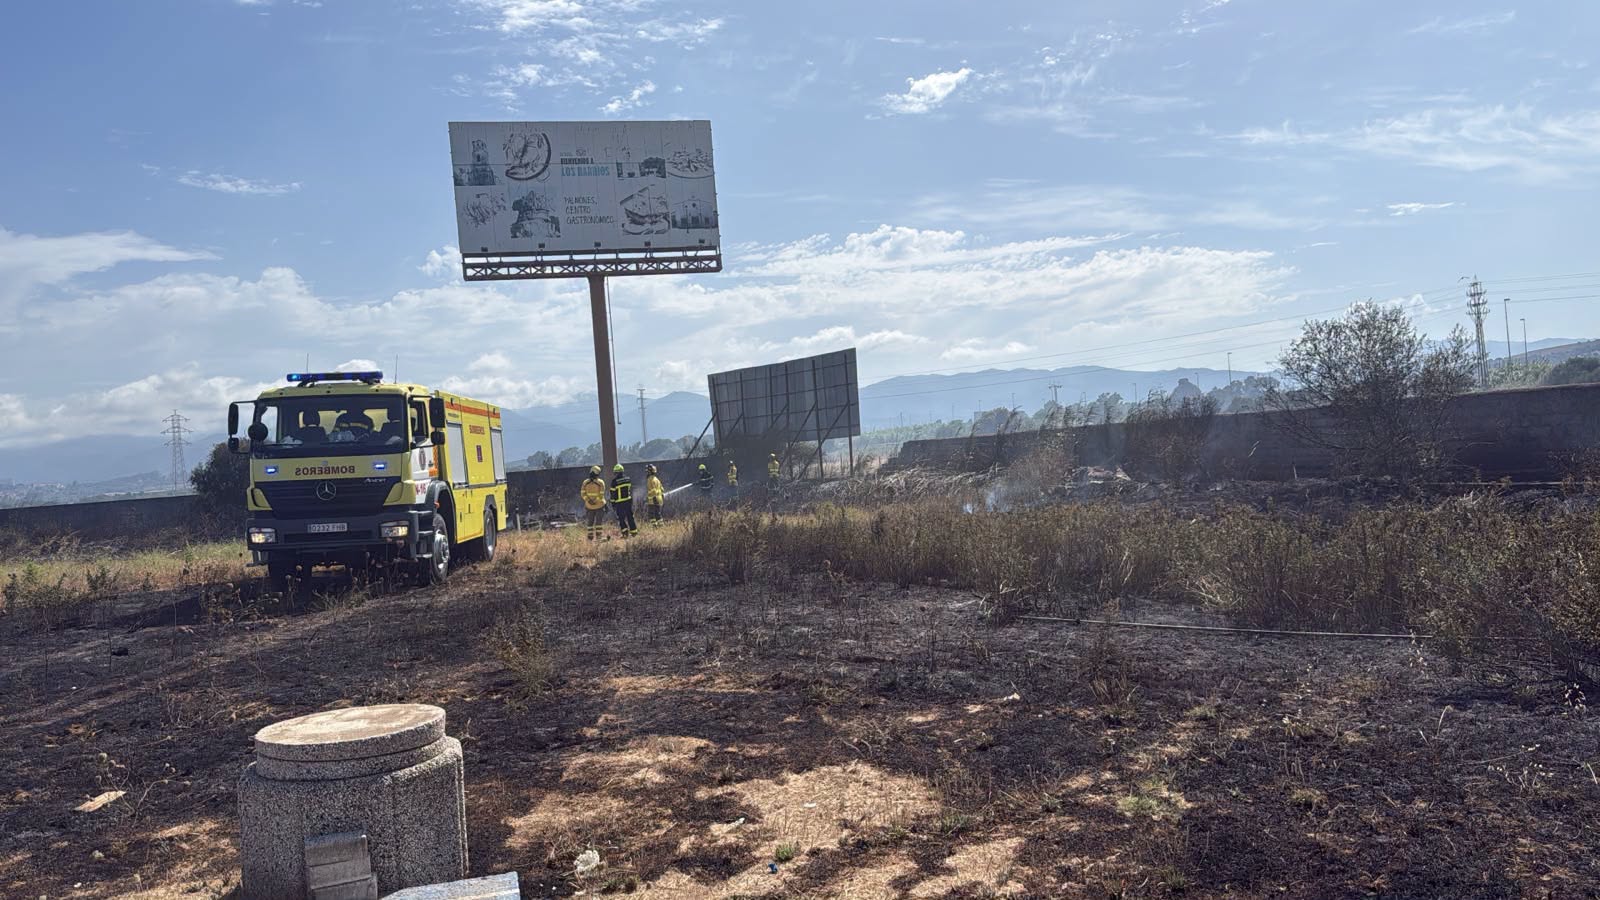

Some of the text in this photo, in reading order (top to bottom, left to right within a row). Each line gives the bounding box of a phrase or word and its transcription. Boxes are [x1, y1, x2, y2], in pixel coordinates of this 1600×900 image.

[561, 166, 610, 177] LOS BARRIOS
[565, 205, 591, 215] CENTRO
